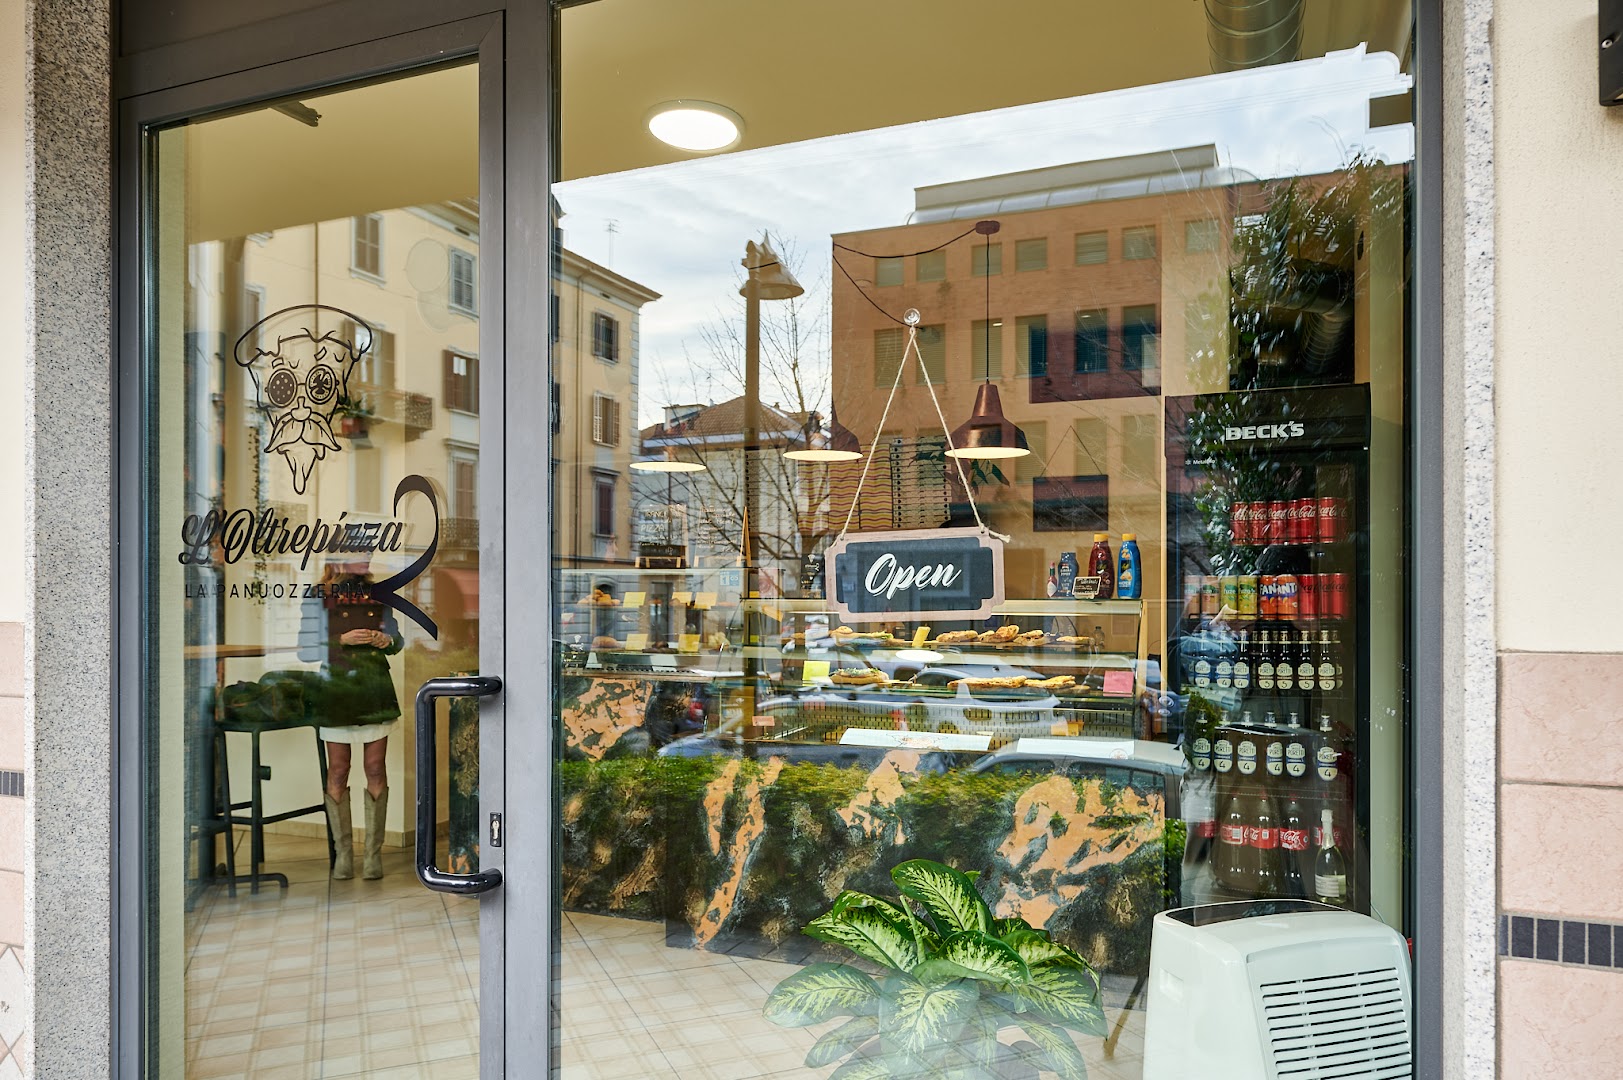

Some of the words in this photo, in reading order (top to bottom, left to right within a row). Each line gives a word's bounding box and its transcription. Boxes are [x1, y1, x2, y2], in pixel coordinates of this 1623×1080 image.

[1225, 420, 1304, 440] BECK'S
[864, 553, 962, 600] Open
[1260, 583, 1276, 595] FAN
[1198, 759, 1204, 767] 4
[1274, 764, 1281, 772] 4
[1324, 769, 1331, 777] 4
